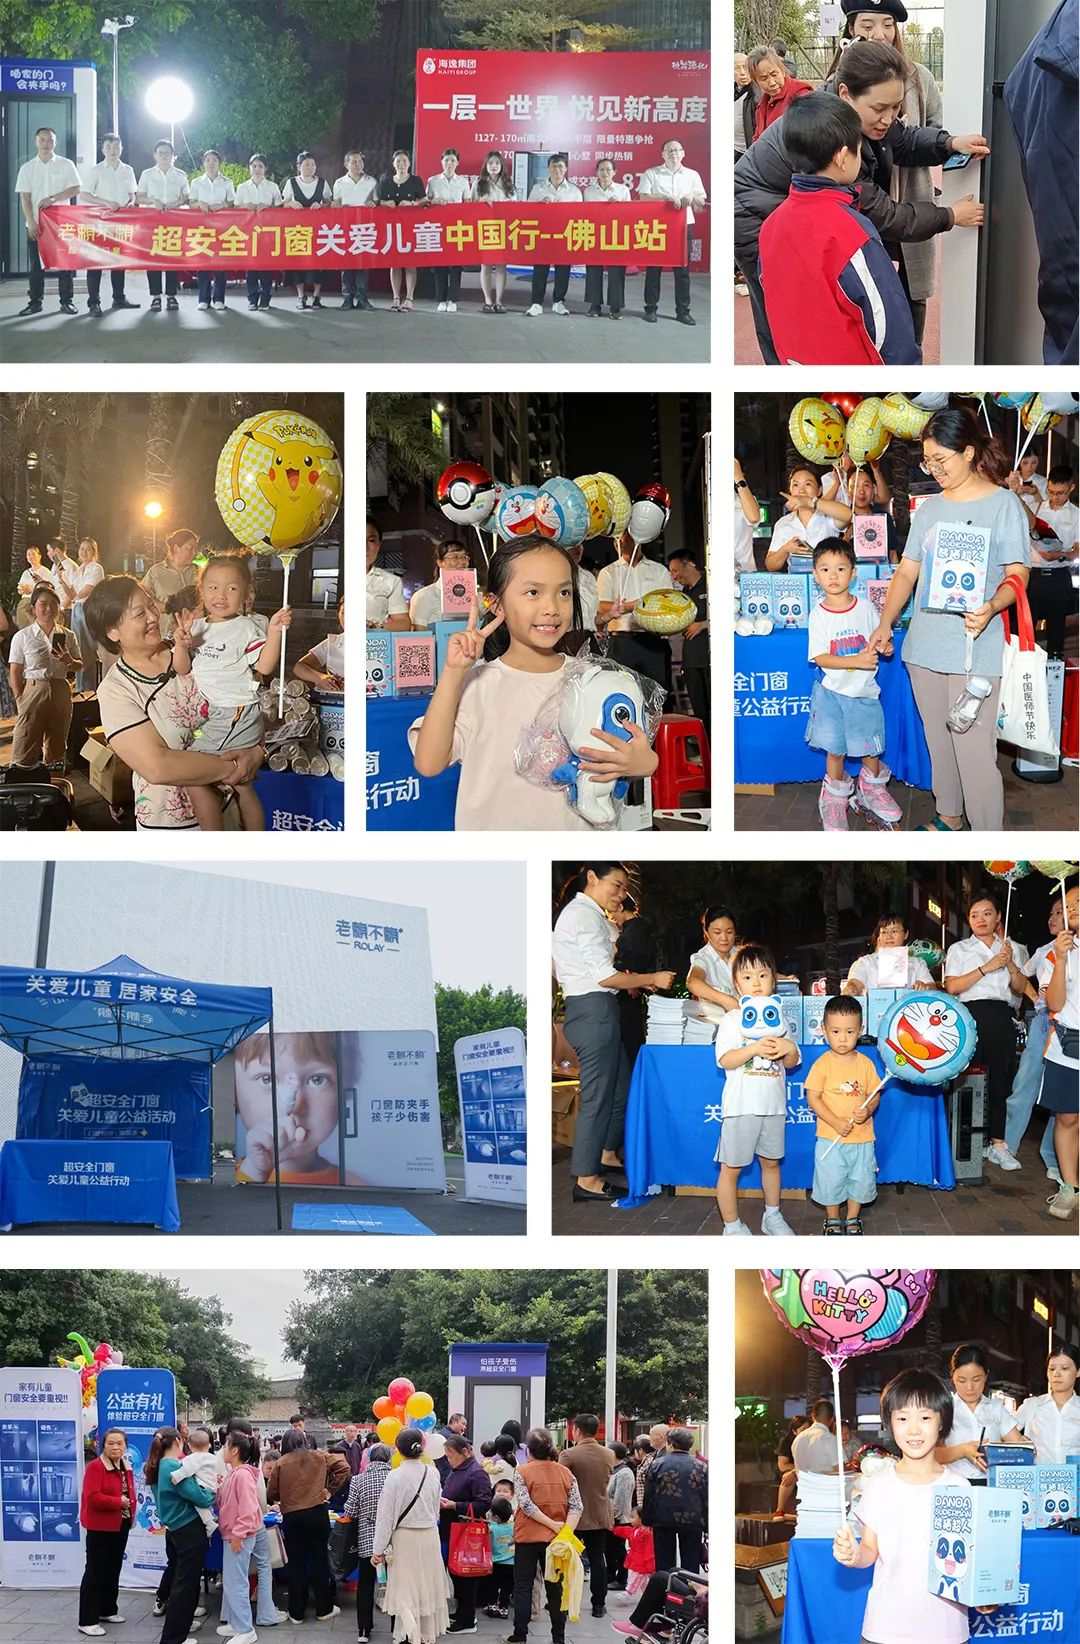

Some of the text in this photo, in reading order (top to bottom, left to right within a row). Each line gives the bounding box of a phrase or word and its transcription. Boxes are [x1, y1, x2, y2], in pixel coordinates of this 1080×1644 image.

[438, 59, 477, 69] 海逸集团
[10, 69, 54, 80] 咱家的门
[422, 94, 708, 123] 一层一世界 悦见新高度
[596, 134, 654, 144] 限量特惠争抢
[595, 151, 634, 161] 同步热销
[1022, 672, 1037, 740] 中国医师节快乐
[366, 776, 420, 811] 行动
[271, 809, 344, 832] 超安全
[353, 940, 385, 953] ROLAY
[26, 974, 198, 1007] 关爱儿童 居家安全
[87, 1093, 160, 1109] 超安全门窗
[370, 1099, 430, 1110] 门窗防夹手
[58, 1108, 176, 1124] 关爱儿童公益活动
[370, 1111, 431, 1123] 孩子少伤害
[63, 1161, 115, 1173] 超安全门窗
[48, 1174, 130, 1187] 关爱儿童公益行动
[813, 1280, 876, 1309] HELLO
[812, 1298, 869, 1325] KITTY
[480, 1357, 517, 1366] 怕孩子受伤
[18, 1382, 53, 1392] 家有儿童
[106, 1392, 165, 1411] 公益有礼
[107, 1411, 165, 1422] 体验超安全门窗
